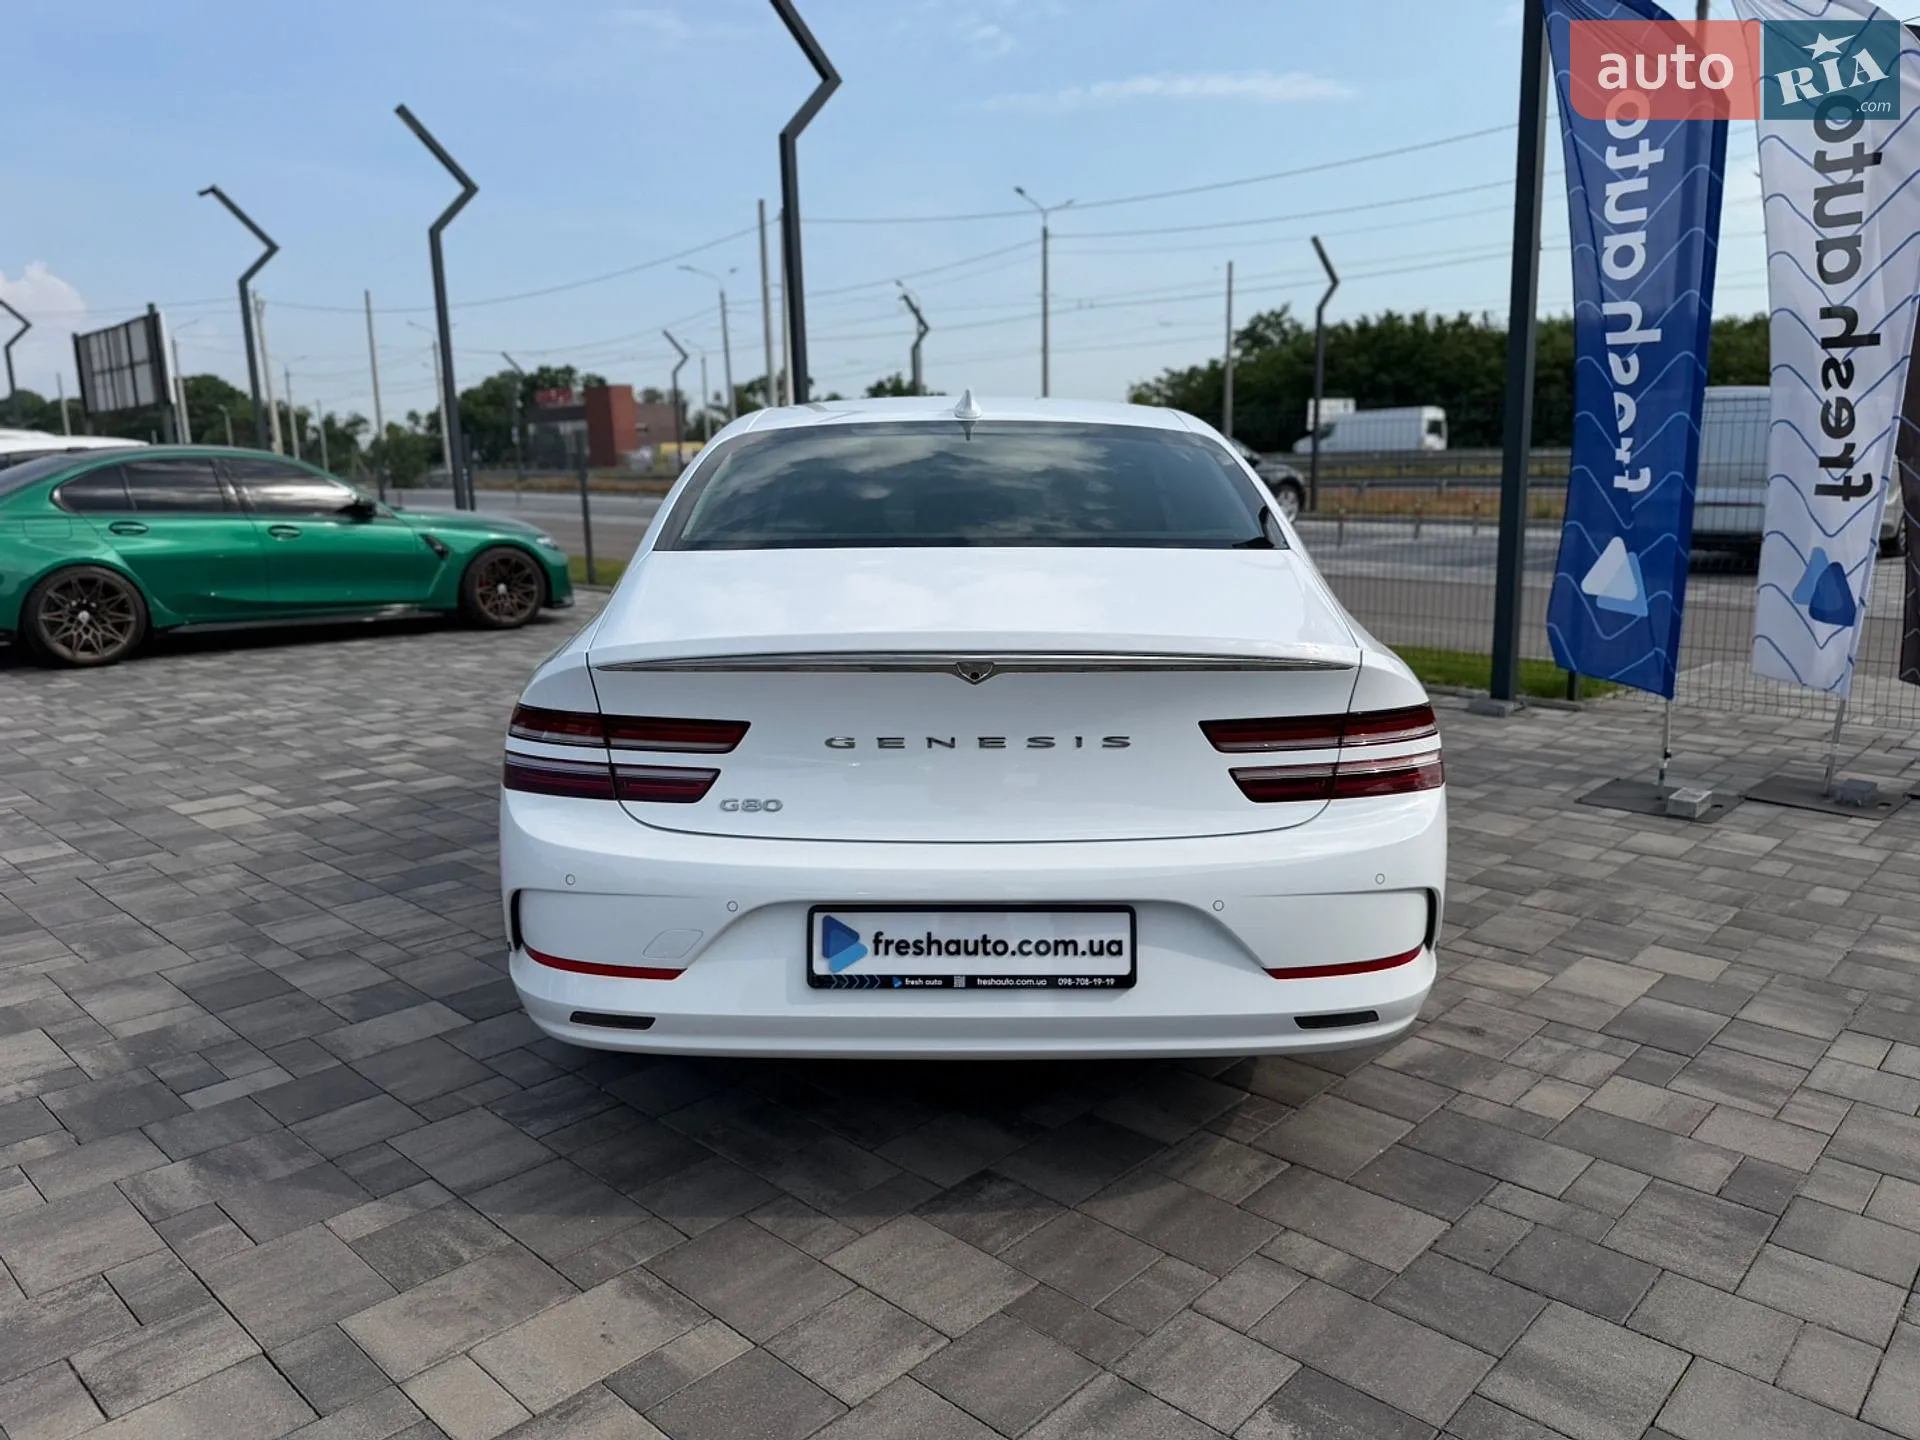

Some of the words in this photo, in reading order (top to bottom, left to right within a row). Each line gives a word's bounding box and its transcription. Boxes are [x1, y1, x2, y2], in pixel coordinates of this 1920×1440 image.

[824, 735, 1131, 749] GENESIS
[719, 798, 783, 813] G80
[873, 930, 1124, 957] freshauto.com.ua
[905, 977, 924, 986] fresh
